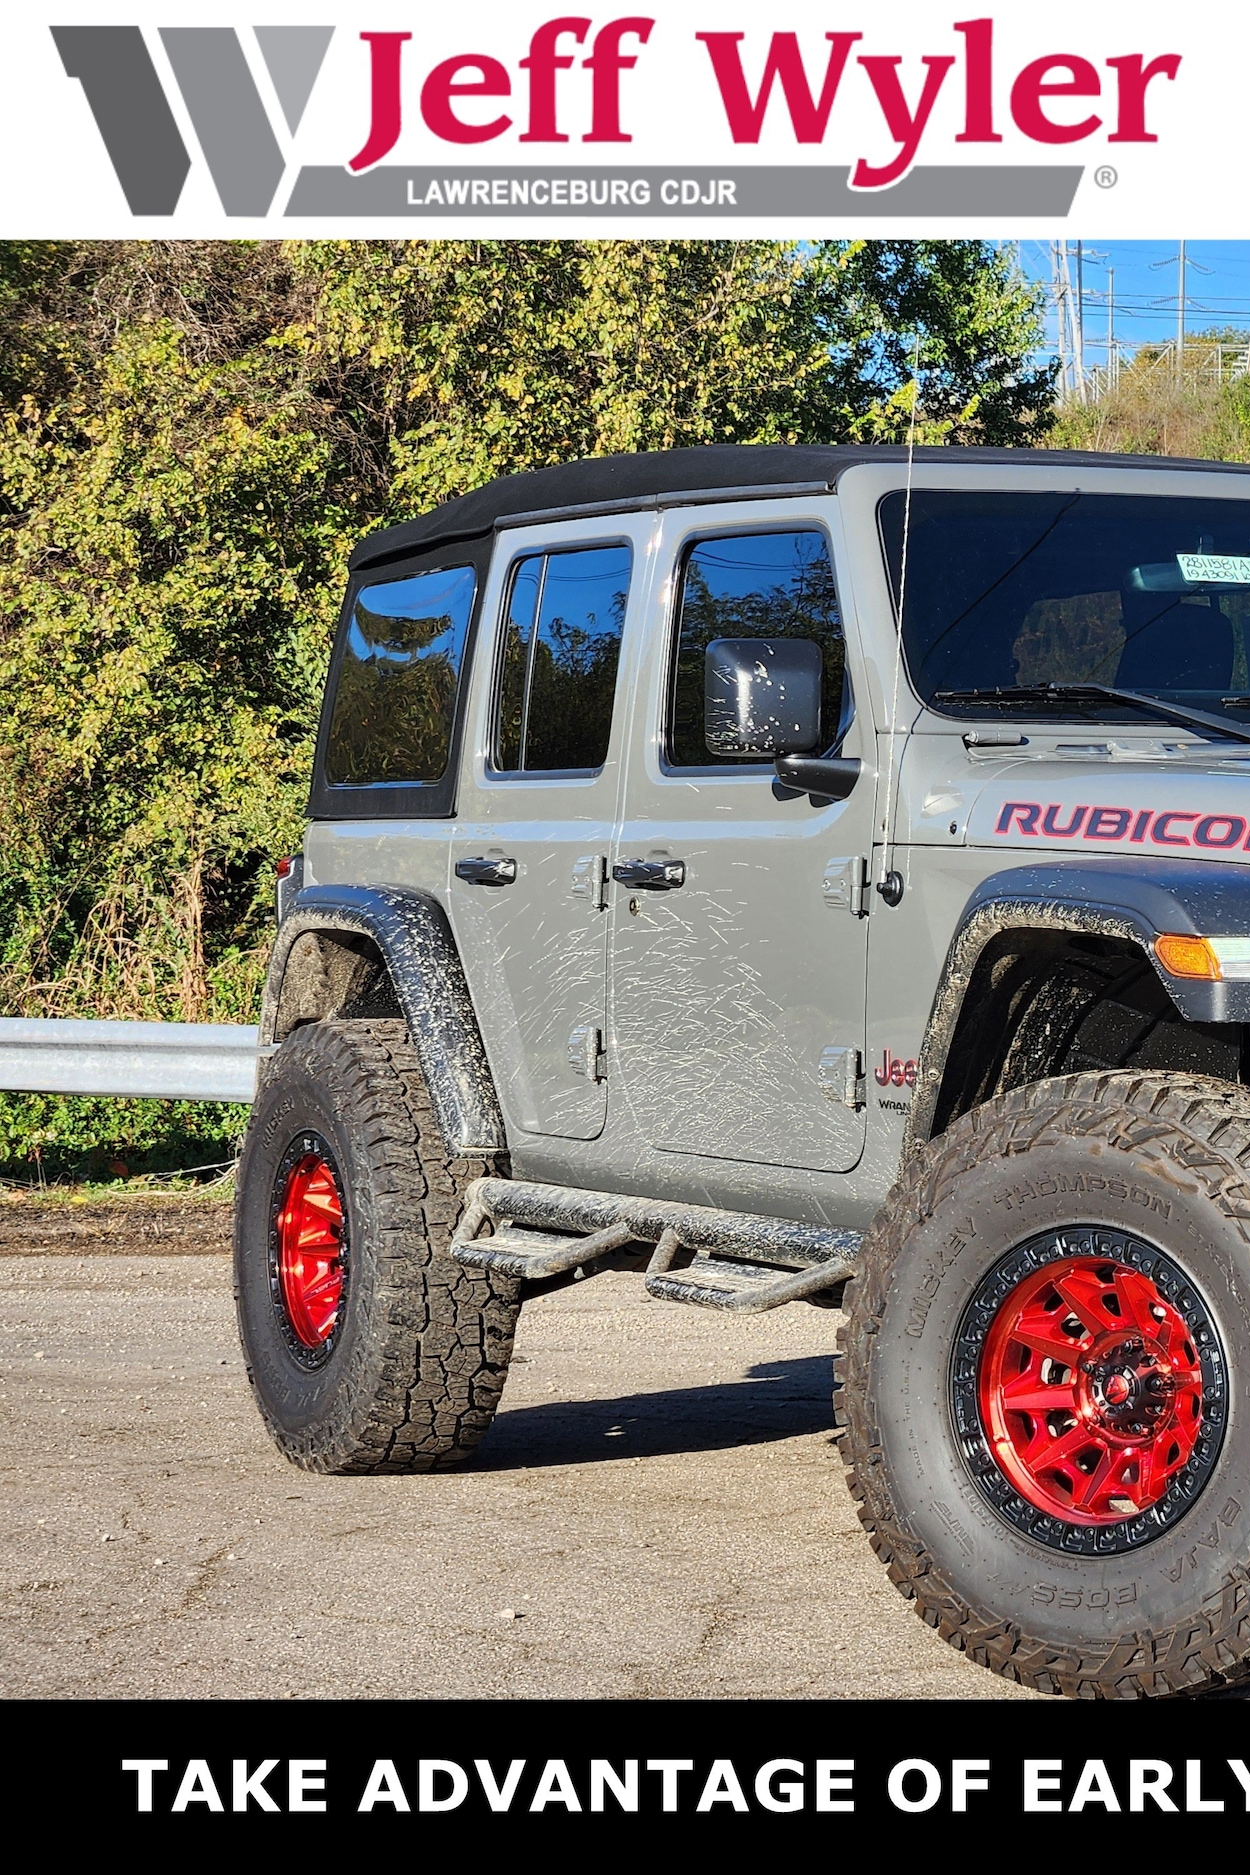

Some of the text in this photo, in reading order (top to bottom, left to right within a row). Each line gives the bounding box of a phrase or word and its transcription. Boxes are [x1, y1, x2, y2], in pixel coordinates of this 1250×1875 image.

[874, 1047, 919, 1088] Jee
[878, 1098, 912, 1112] WRAN
[904, 1171, 1173, 1340] MICKEY THOMPSON
[962, 1489, 1005, 1536] OUTSIDE
[1159, 1496, 1242, 1585] BAJA
[1031, 1581, 1138, 1610] BOSS
